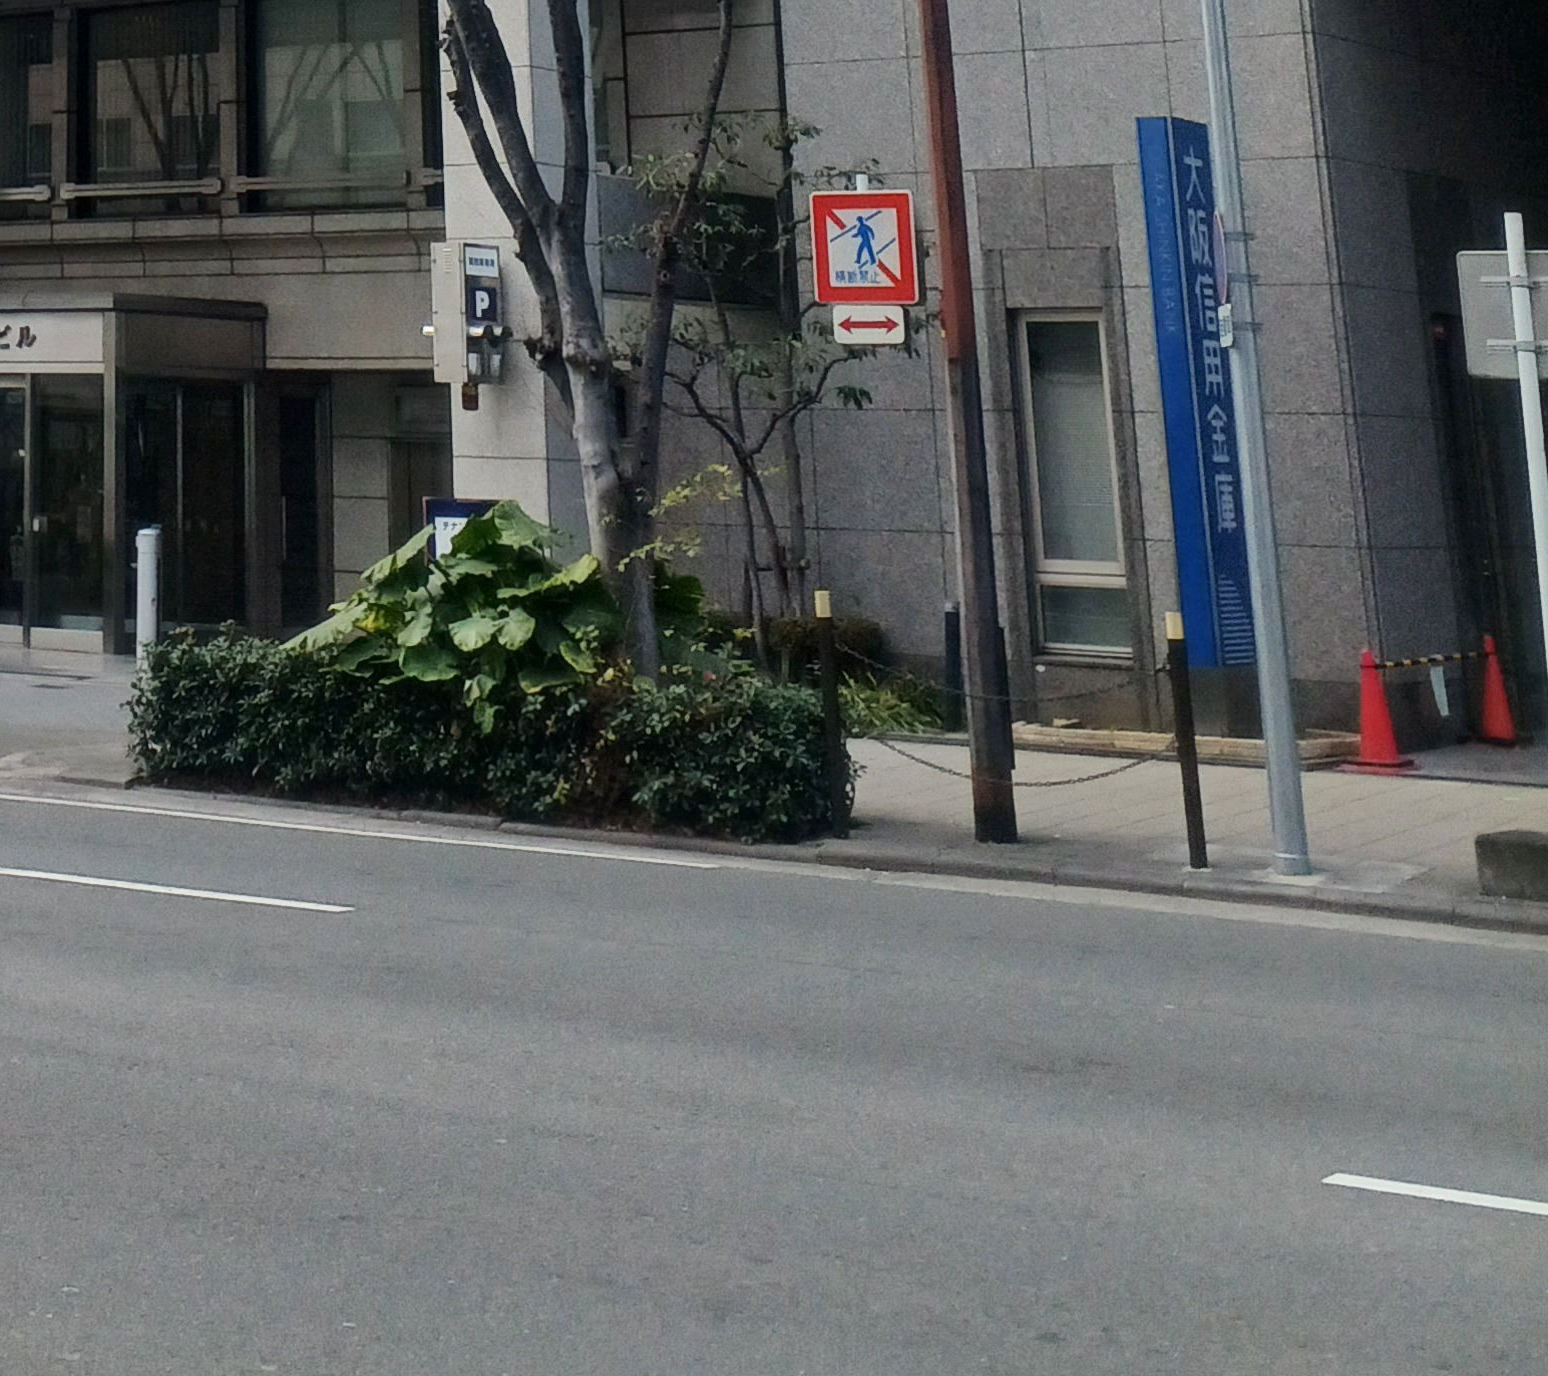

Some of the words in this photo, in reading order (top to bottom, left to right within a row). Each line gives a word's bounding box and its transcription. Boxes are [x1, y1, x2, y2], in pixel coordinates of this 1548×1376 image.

[475, 290, 490, 318] P
[1183, 145, 1237, 533] 大阪信用金庫
